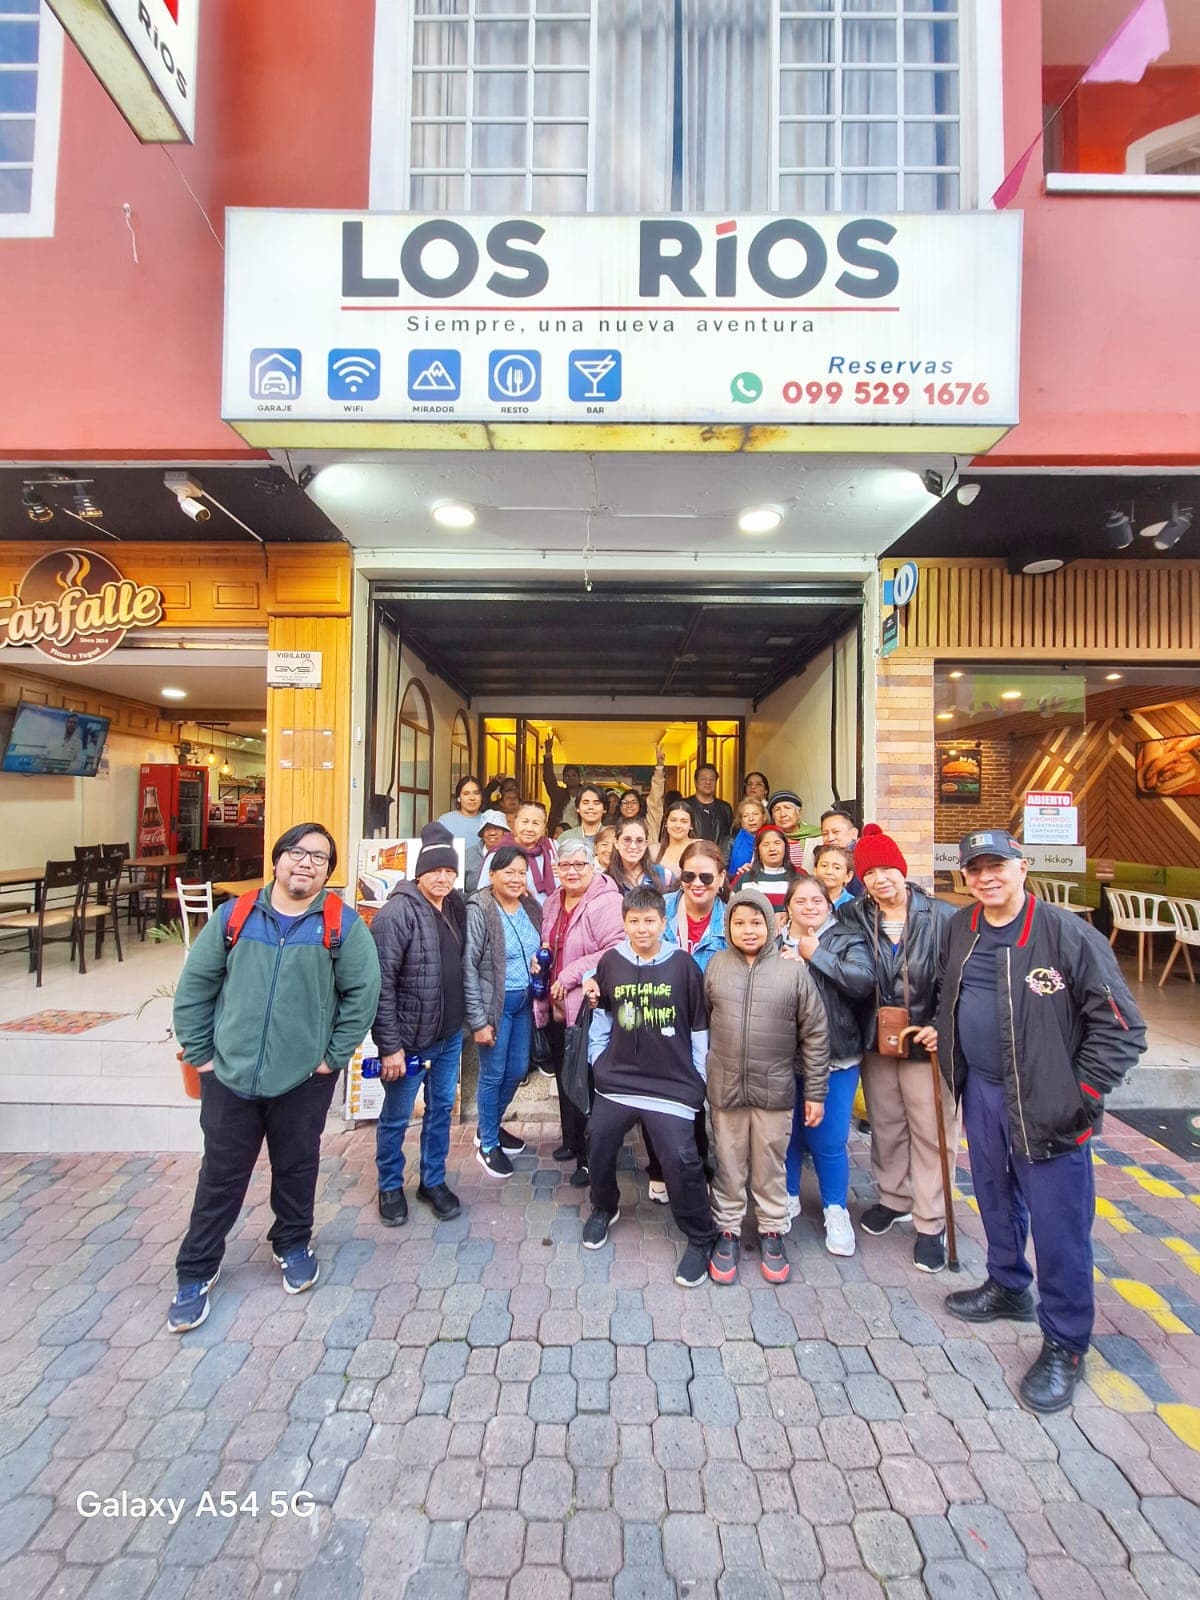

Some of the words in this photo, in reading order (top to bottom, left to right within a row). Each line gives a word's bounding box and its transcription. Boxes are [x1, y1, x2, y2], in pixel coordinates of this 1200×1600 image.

[342, 219, 549, 299] LOS
[407, 315, 525, 335] Siempre,
[538, 319, 583, 332] una
[599, 318, 674, 332] nueva
[696, 316, 814, 332] aventura
[828, 356, 953, 374] Reservas
[782, 381, 843, 404] 099
[854, 381, 910, 405] 529
[923, 382, 990, 405] 1676
[257, 404, 292, 412] GARAJE
[412, 405, 455, 413] MIRADOR
[501, 406, 529, 414] RESTO
[586, 406, 604, 414] BAR
[1027, 794, 1071, 807] ABIERTO
[934, 852, 960, 865] ickory
[1044, 853, 1074, 867] Hickory
